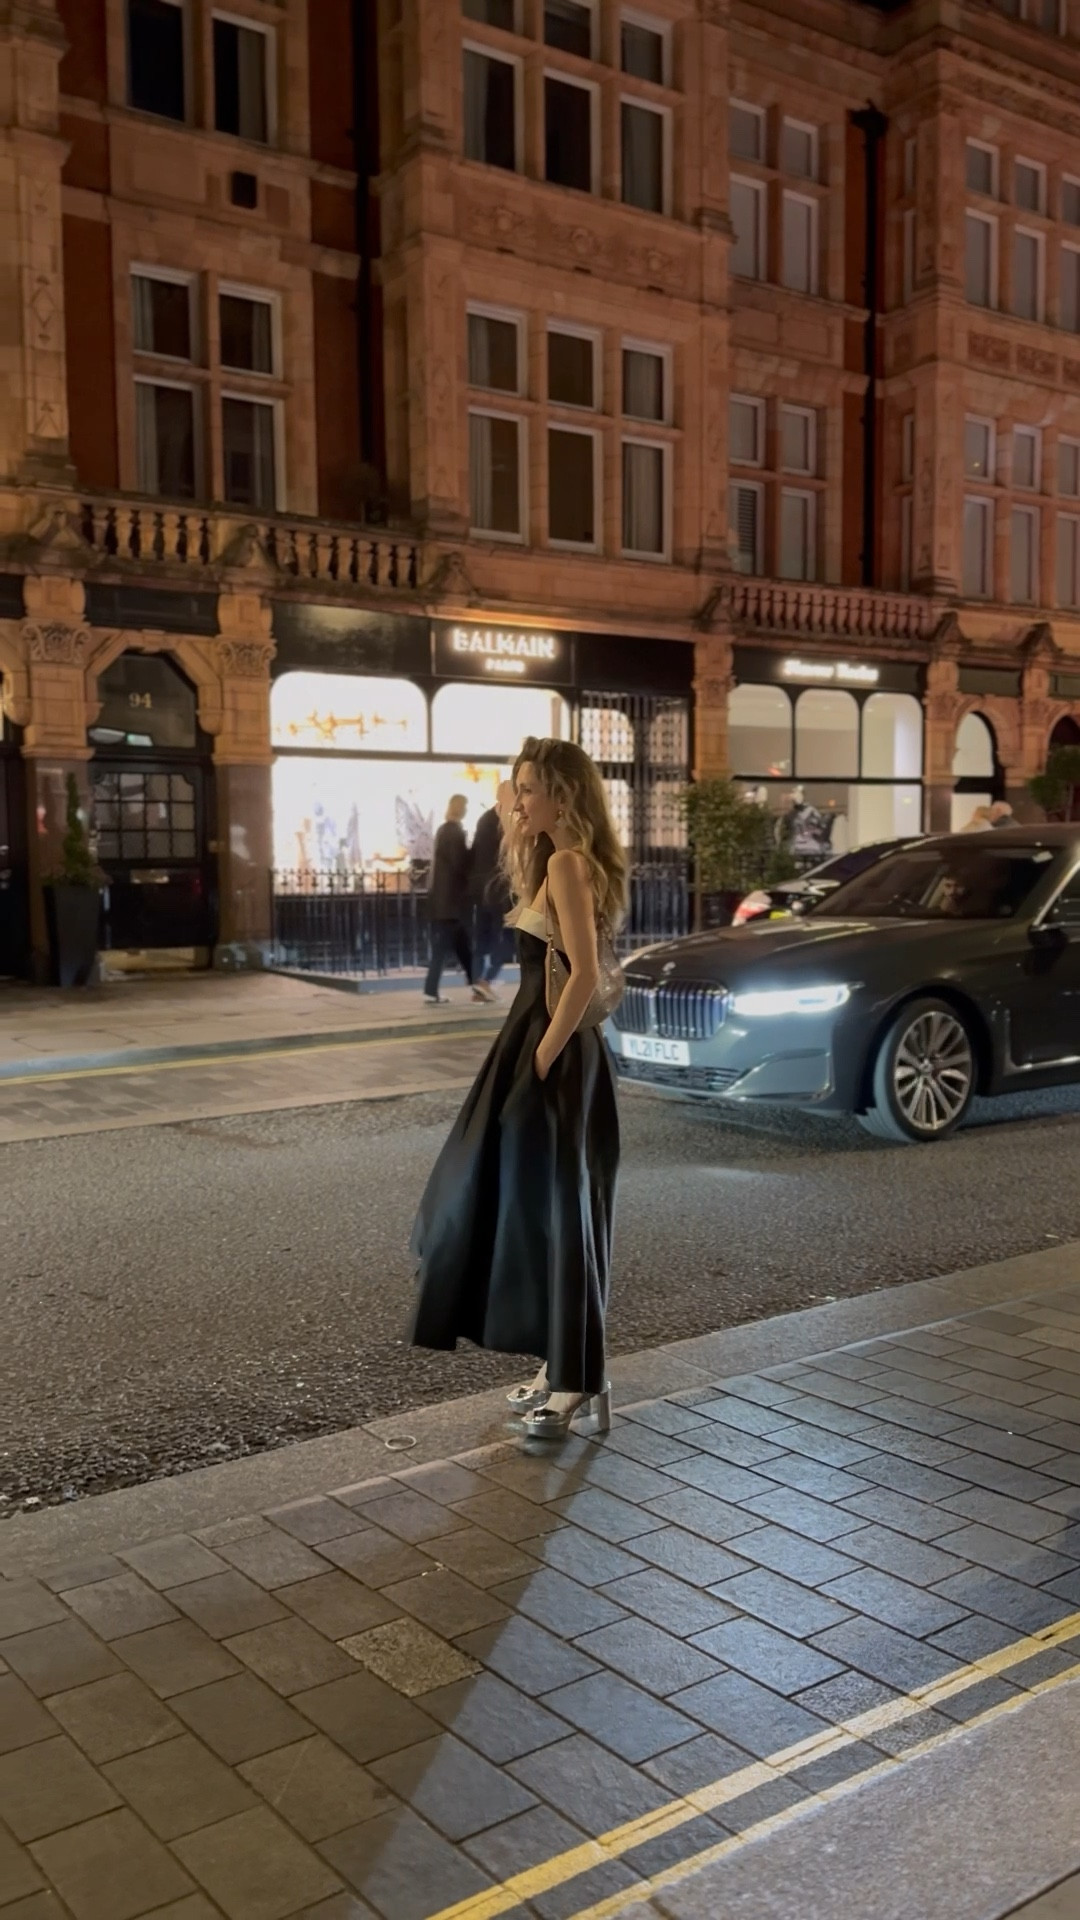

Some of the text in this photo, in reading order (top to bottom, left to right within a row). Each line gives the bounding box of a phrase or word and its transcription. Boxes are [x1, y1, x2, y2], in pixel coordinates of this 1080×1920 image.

[452, 628, 555, 659] BALMAIN
[128, 692, 152, 709] 94
[654, 1042, 679, 1061] FLC
